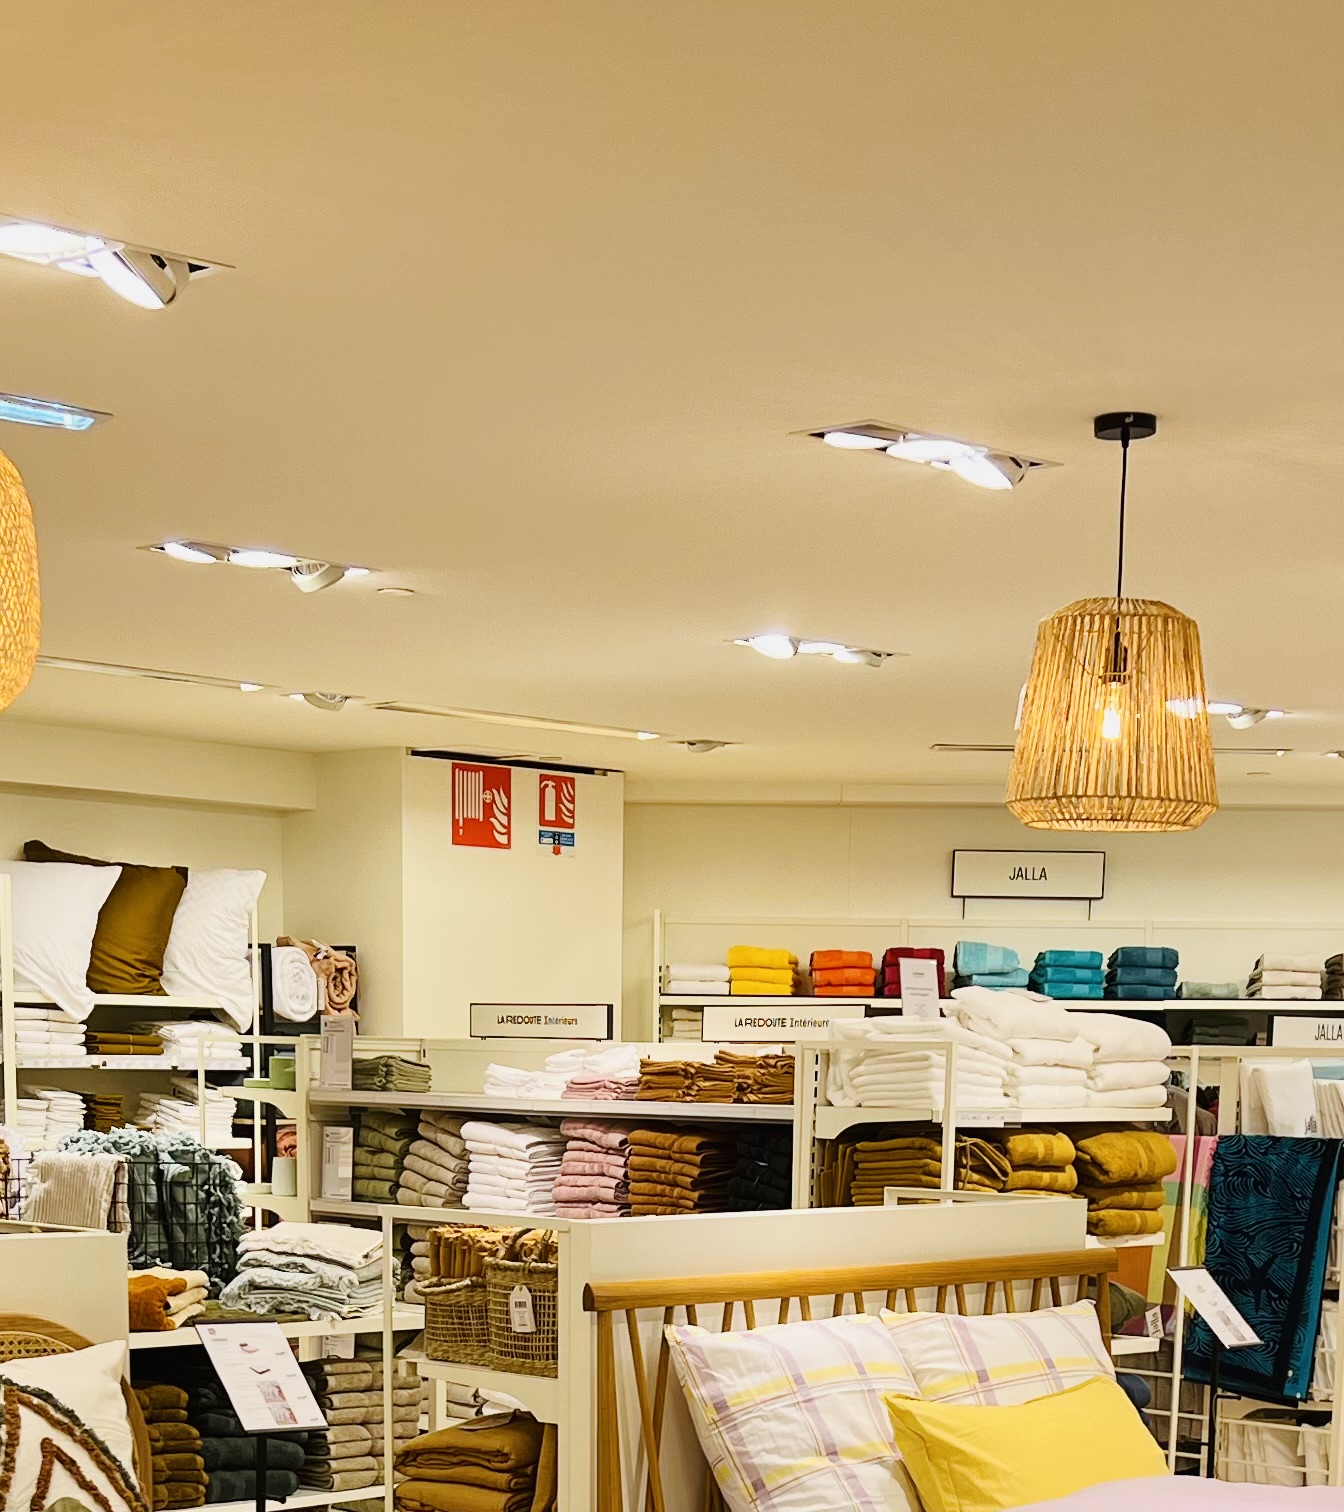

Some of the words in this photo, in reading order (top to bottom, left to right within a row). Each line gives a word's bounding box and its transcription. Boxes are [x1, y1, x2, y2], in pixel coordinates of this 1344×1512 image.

[1009, 866, 1048, 881] JALLA
[497, 1015, 505, 1025] LA
[506, 1015, 542, 1025] REDOUTE
[734, 1018, 743, 1028] LA
[745, 1018, 787, 1028] REDOUTE
[1314, 1024, 1343, 1041] JALLA
